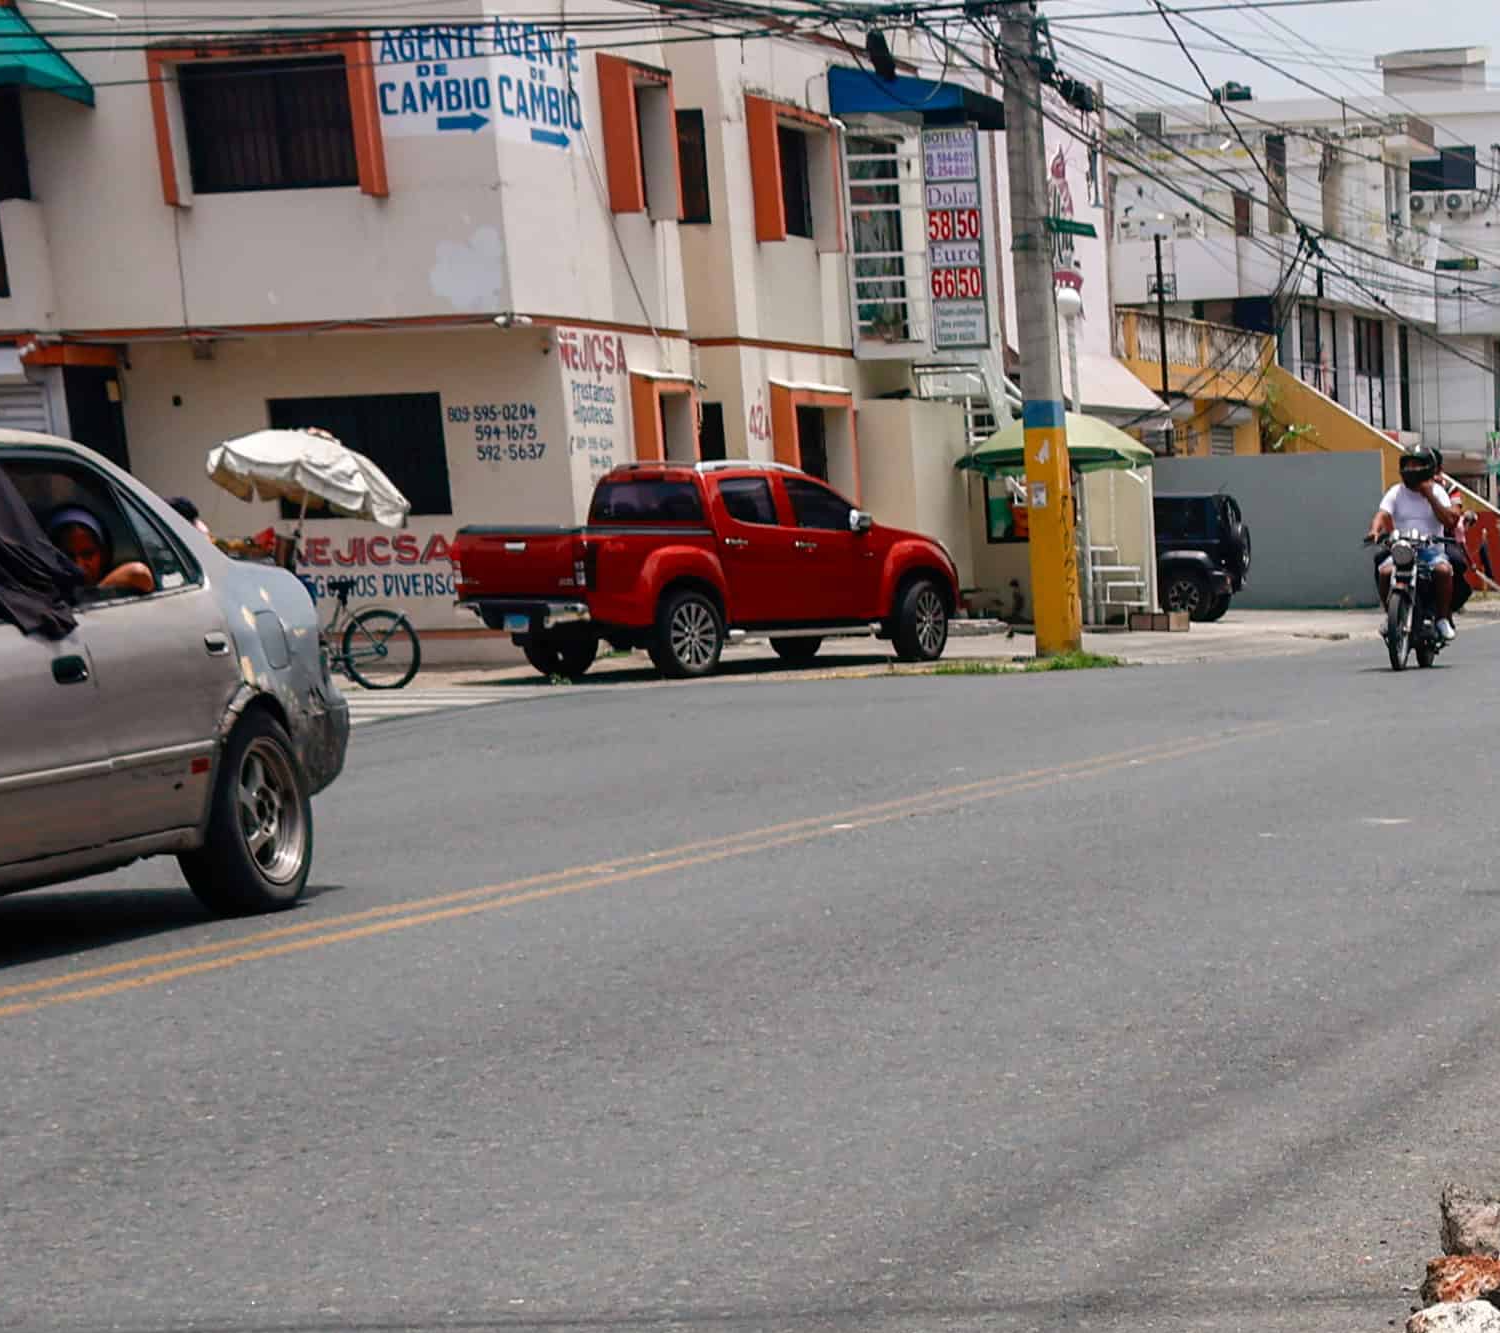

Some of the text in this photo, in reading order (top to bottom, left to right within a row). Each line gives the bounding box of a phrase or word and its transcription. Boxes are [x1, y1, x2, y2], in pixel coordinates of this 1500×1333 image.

[379, 26, 485, 63] AGENTE
[416, 63, 448, 77] DE
[530, 66, 546, 81] DE
[379, 77, 491, 115] CAMBIO
[498, 74, 584, 132] CAMBIO
[927, 186, 975, 207] Dolar
[928, 208, 979, 240] 58 50
[931, 247, 980, 263] Euro
[931, 267, 980, 298] 66 50
[475, 423, 538, 442] 594-1675
[297, 533, 453, 567] EJICSA
[382, 572, 457, 598] DIVERSO
